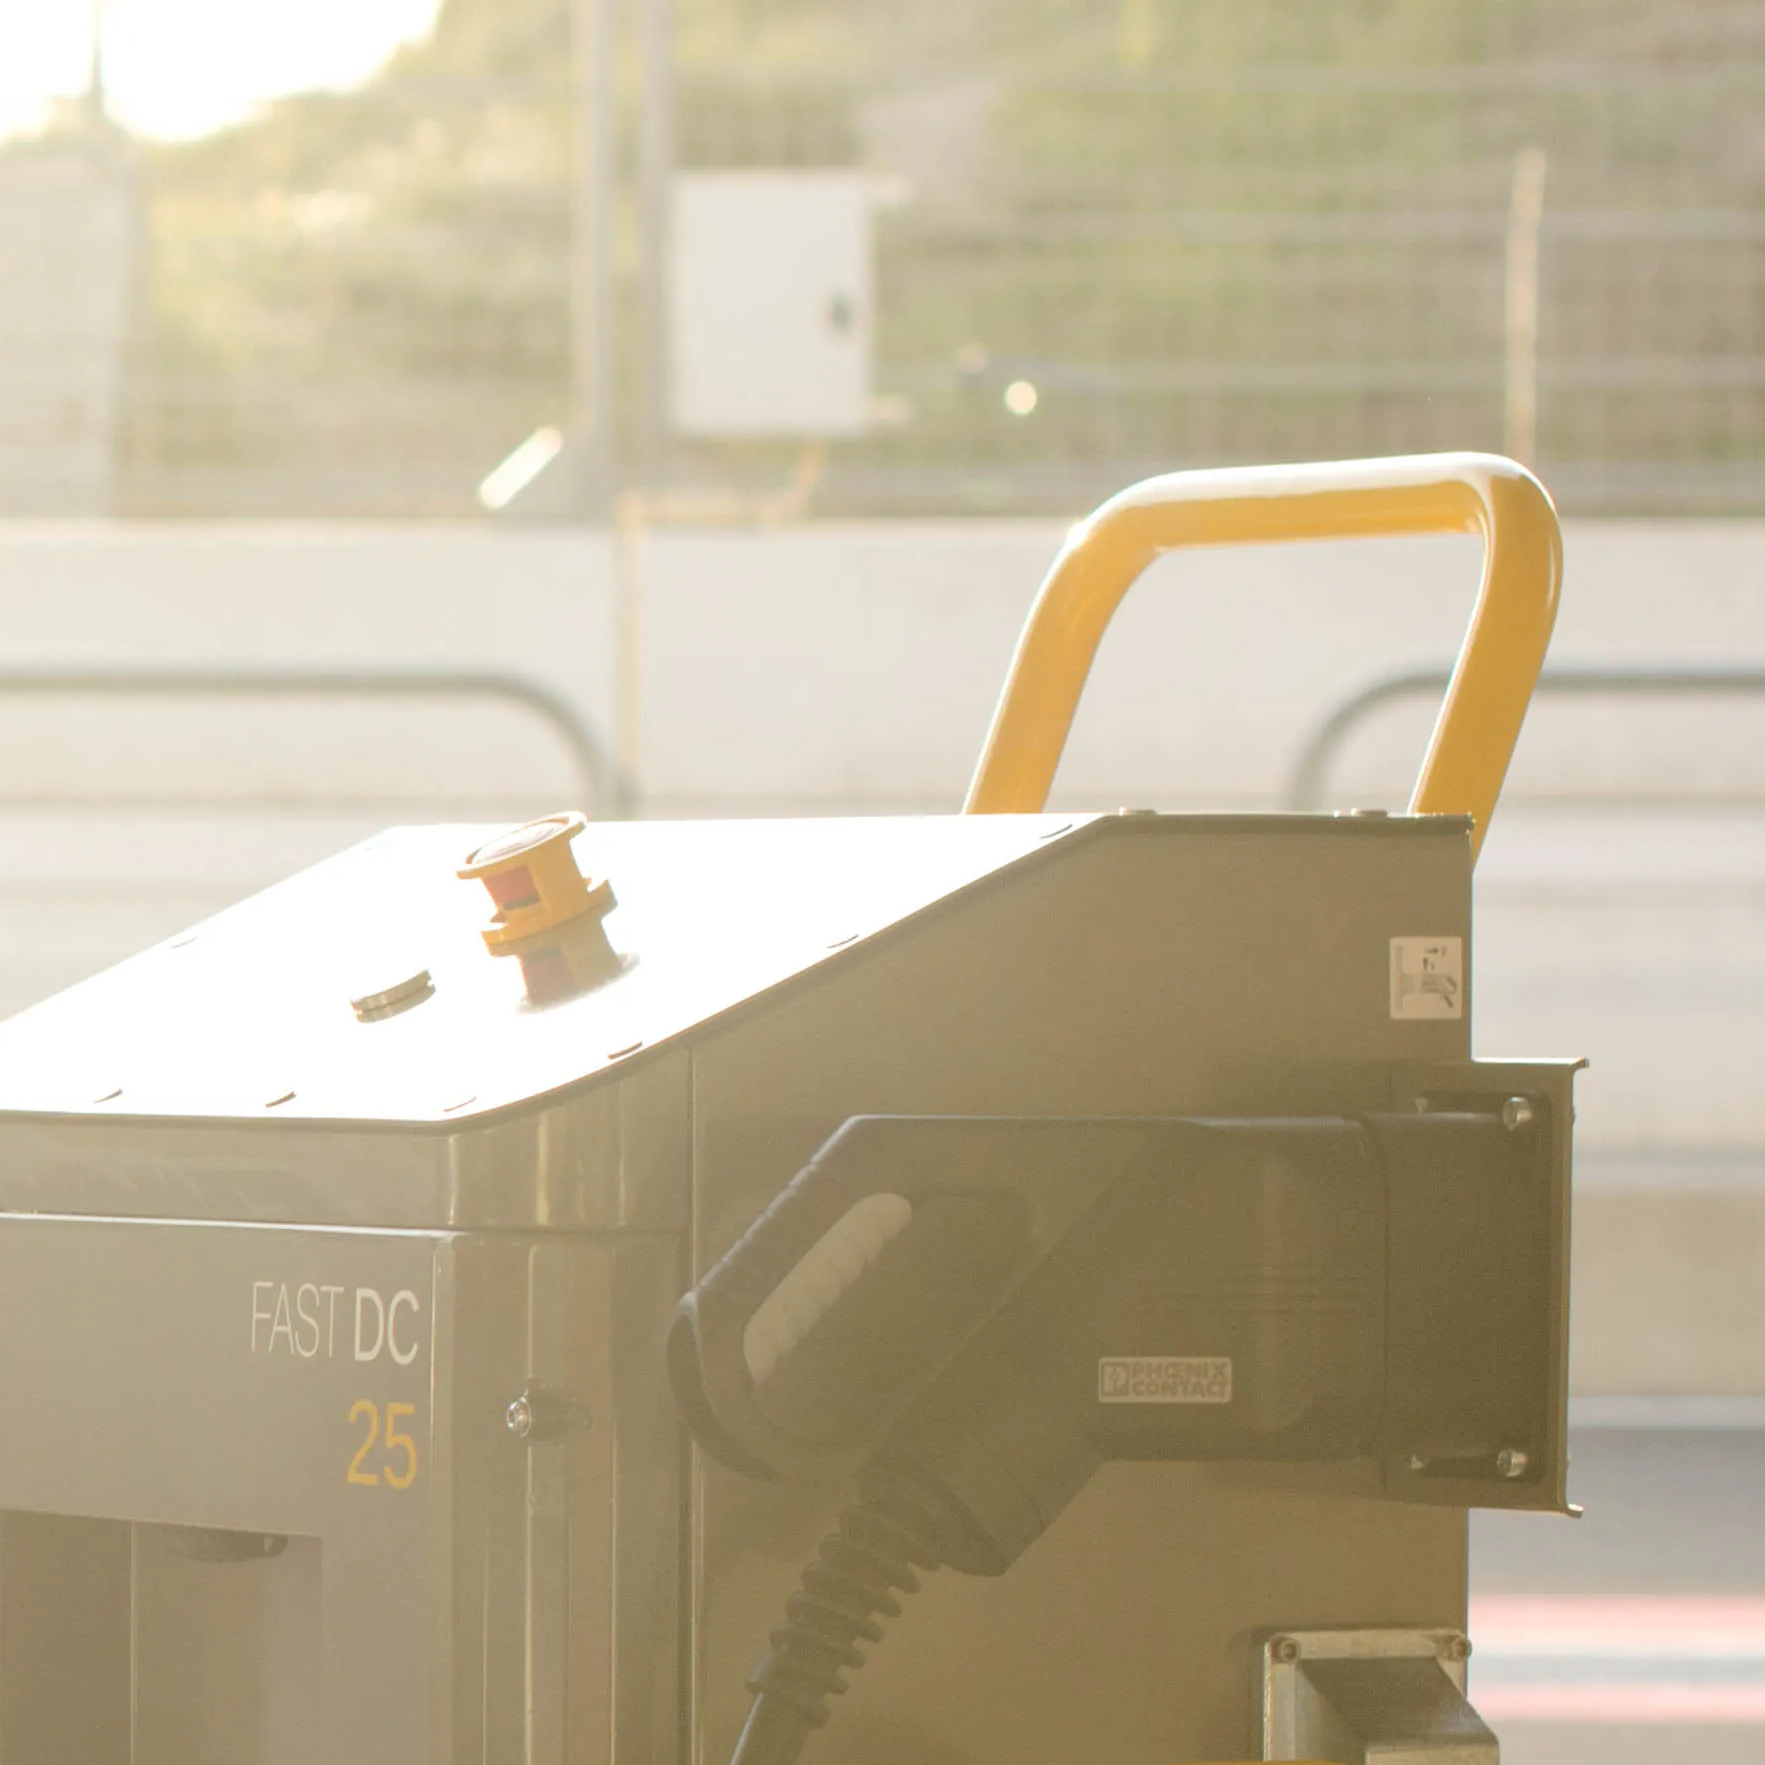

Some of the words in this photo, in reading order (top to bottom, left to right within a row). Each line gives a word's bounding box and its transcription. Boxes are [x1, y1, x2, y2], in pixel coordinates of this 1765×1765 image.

[251, 1281, 345, 1358] FAST
[354, 1287, 420, 1366] DC
[1132, 1379, 1228, 1398] CONTACT
[346, 1399, 418, 1489] 25
